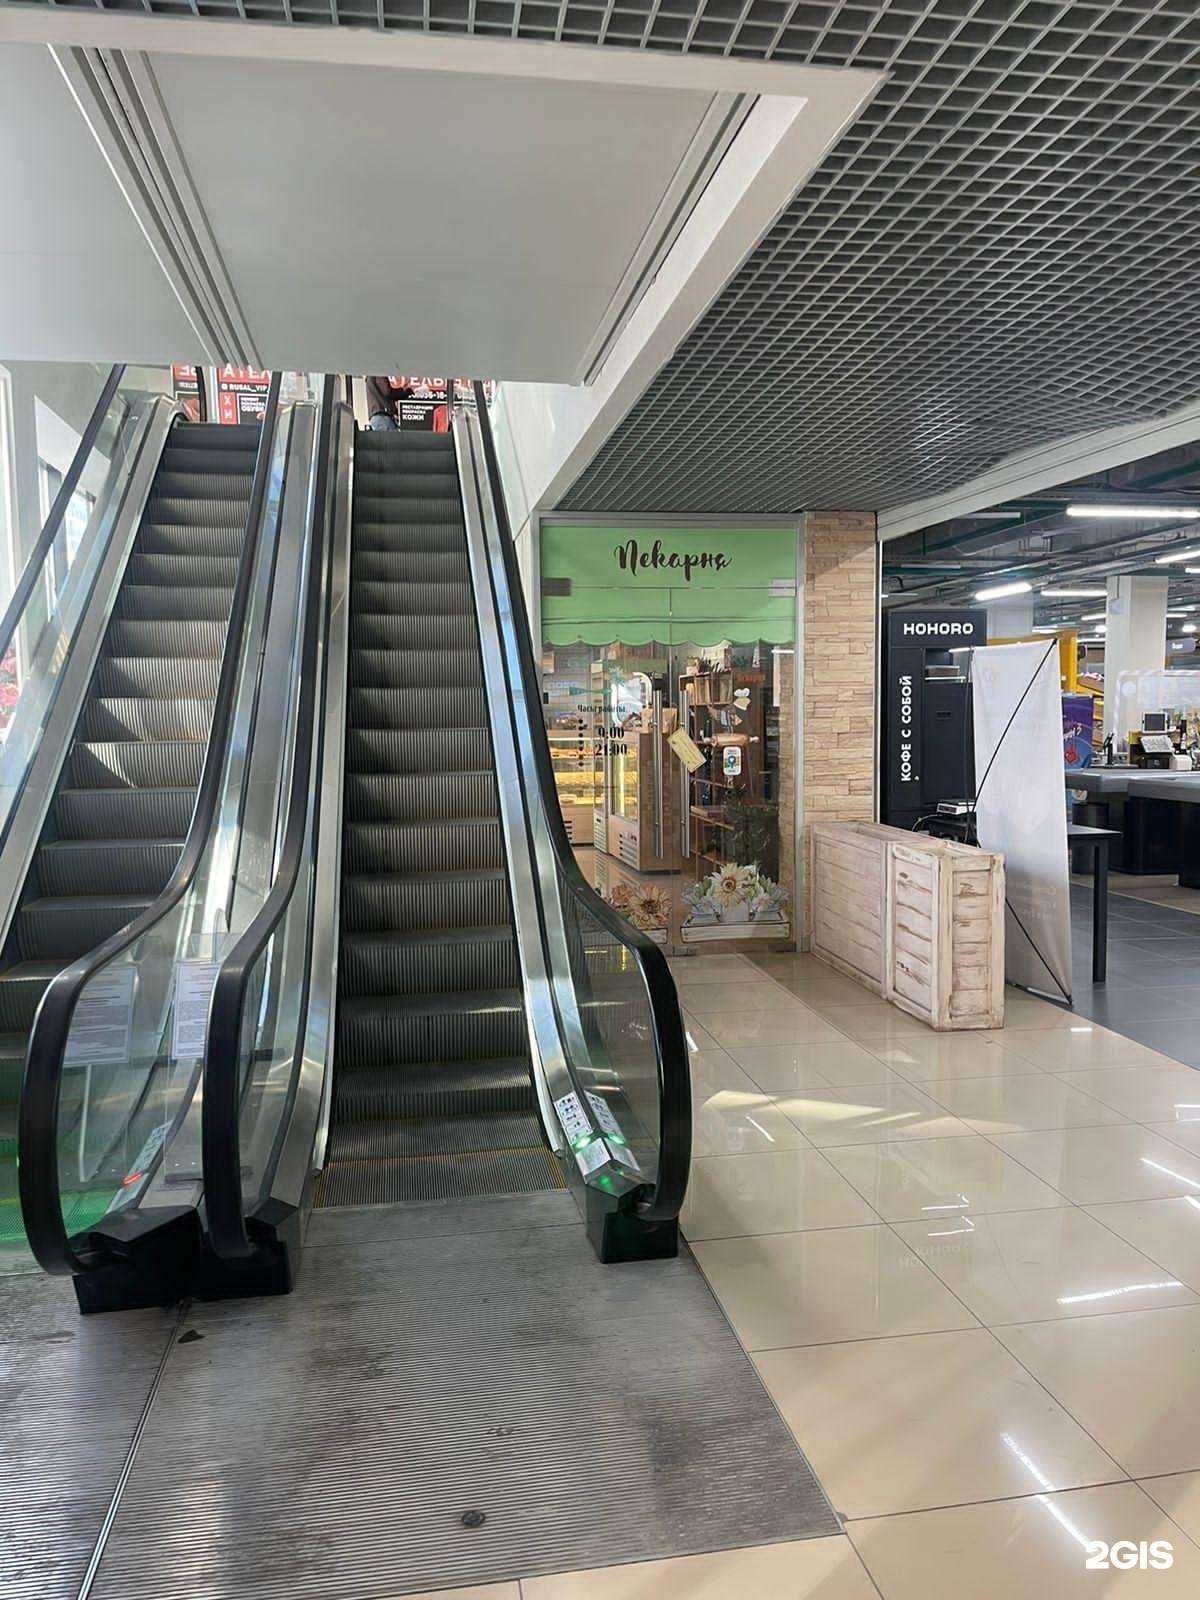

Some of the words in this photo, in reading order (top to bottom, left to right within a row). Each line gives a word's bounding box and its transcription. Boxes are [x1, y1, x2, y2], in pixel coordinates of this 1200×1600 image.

[614, 539, 732, 581] Пекарня
[899, 675, 912, 724] СОБОЙ
[595, 743, 628, 757] 21:00
[901, 729, 912, 738] С
[900, 743, 912, 782] КОФЕ
